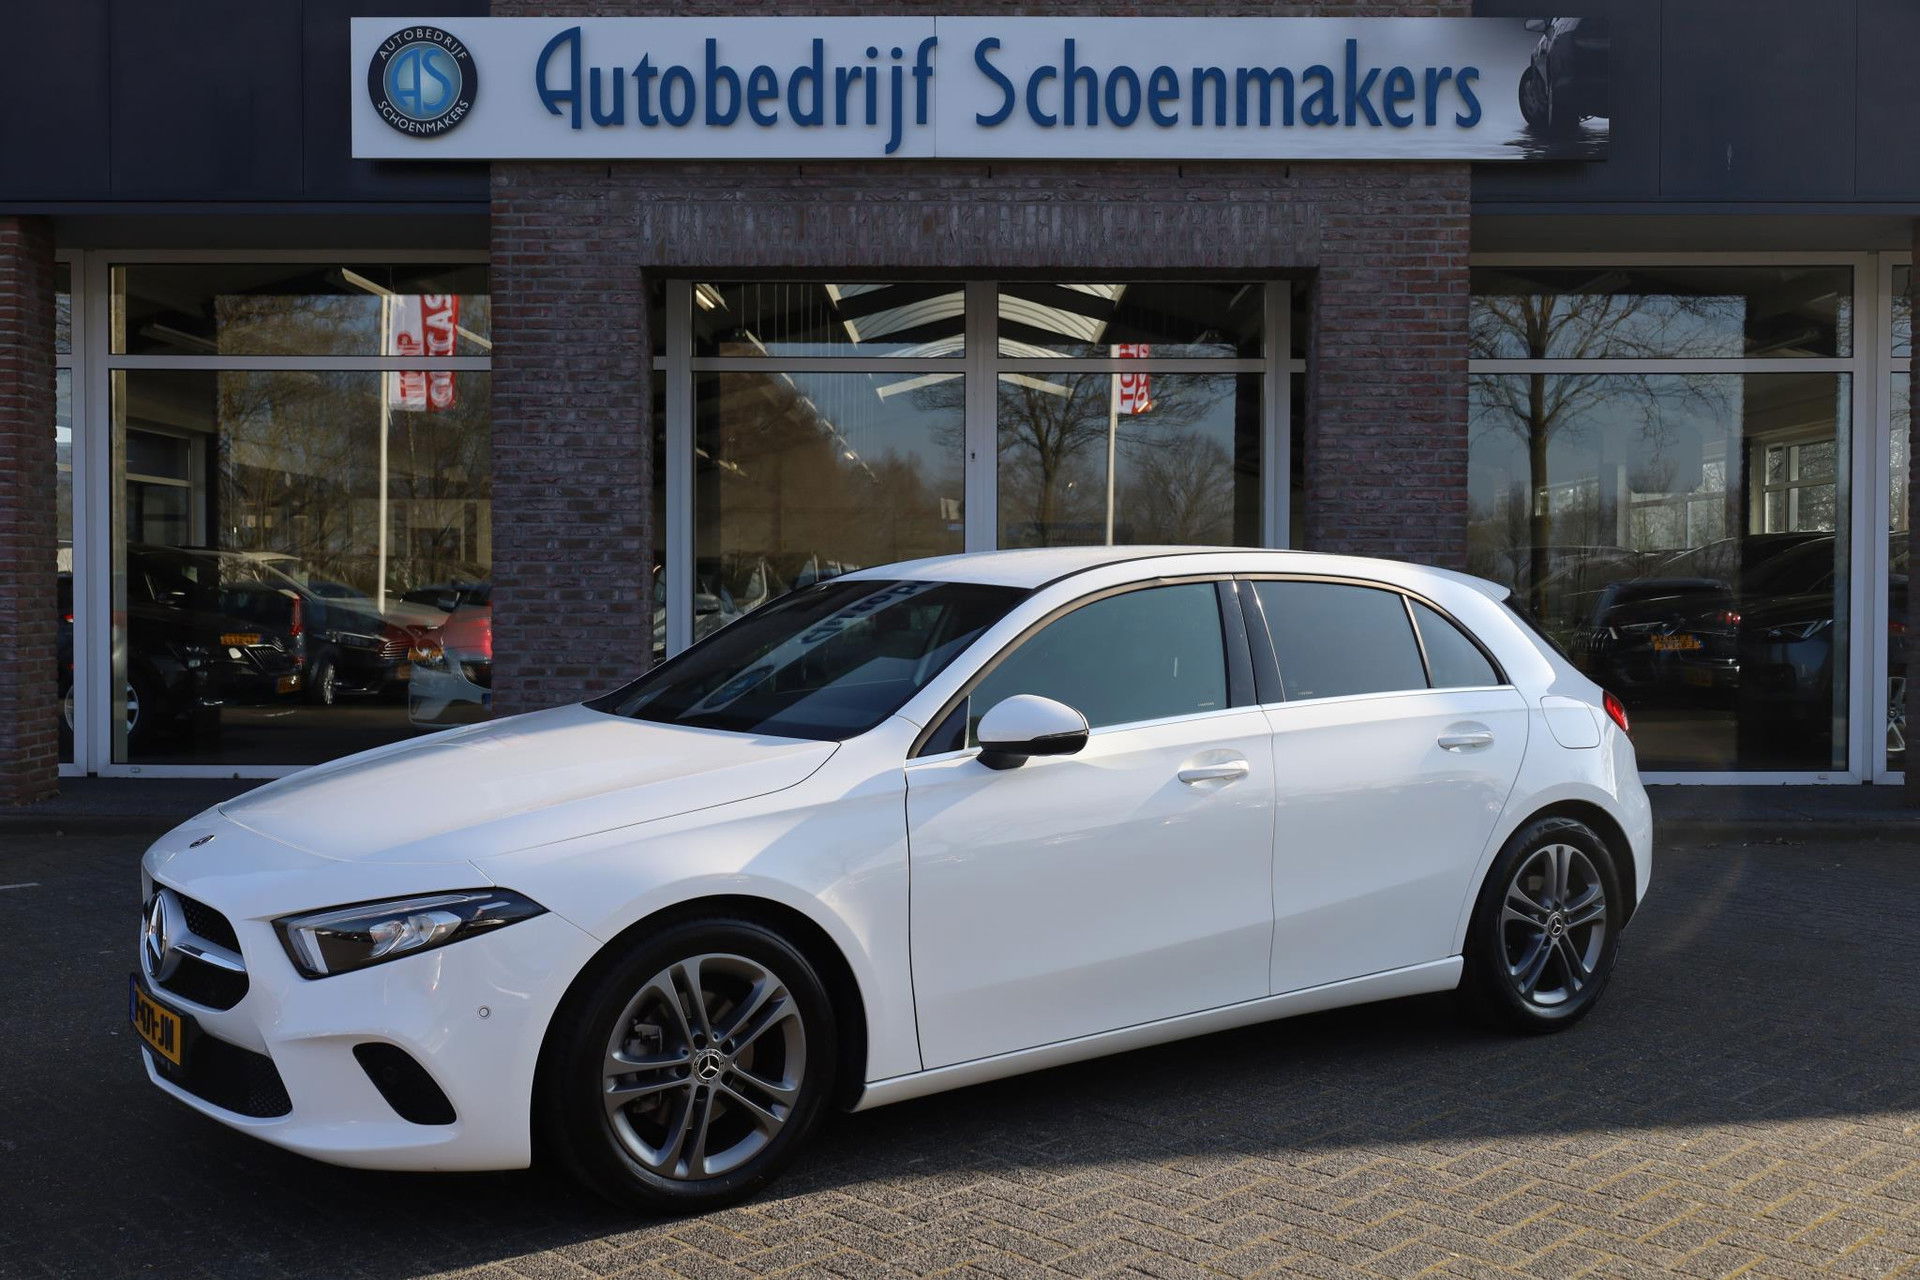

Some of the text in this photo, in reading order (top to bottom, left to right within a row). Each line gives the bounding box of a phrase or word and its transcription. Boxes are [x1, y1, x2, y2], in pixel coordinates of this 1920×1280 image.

[378, 28, 468, 60] AUTOBEDRIJF
[391, 47, 452, 117] AS
[535, 26, 1482, 154] Autobedrijf Schoenmakers
[378, 100, 469, 133] SCHOENMAKERS
